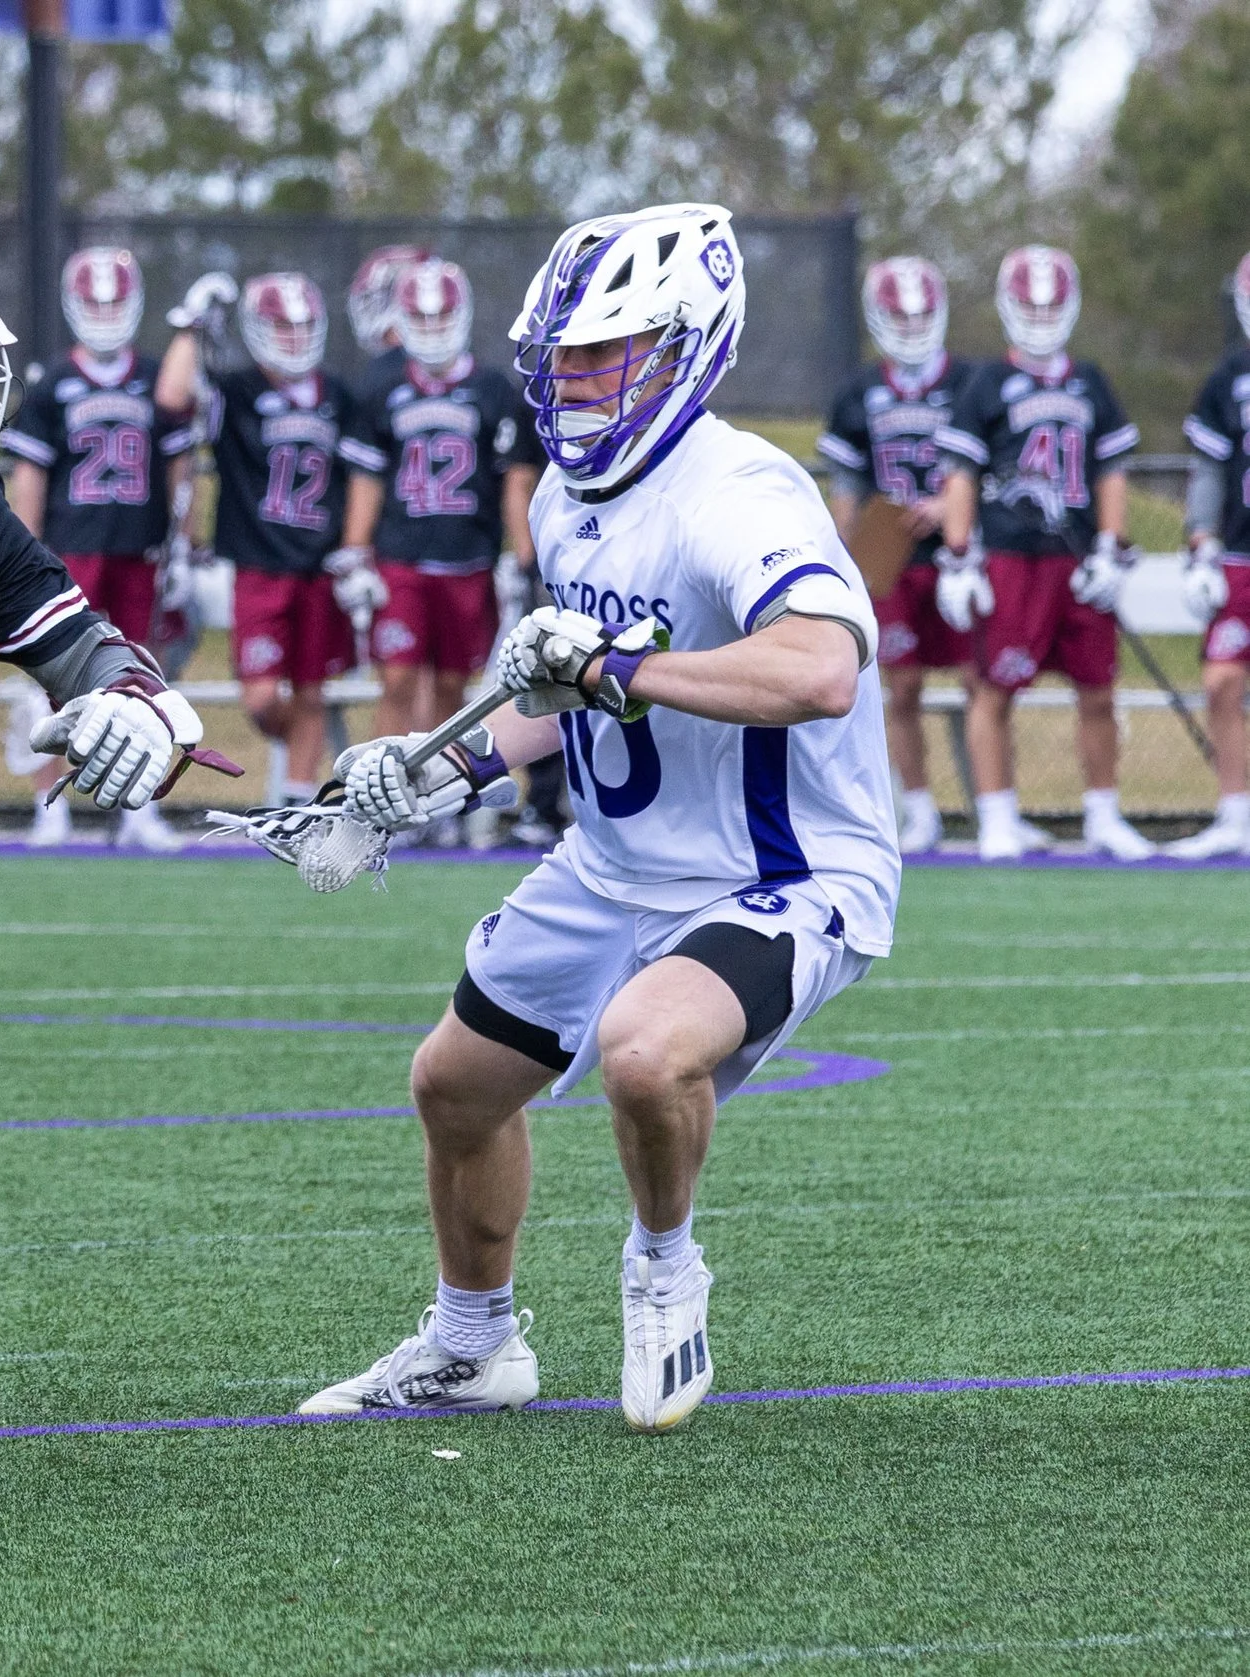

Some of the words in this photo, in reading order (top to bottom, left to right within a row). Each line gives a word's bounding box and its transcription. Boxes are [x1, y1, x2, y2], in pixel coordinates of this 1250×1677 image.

[68, 424, 151, 505] 29
[259, 443, 331, 531] 12
[395, 432, 478, 517] 42
[1017, 421, 1090, 508] 41
